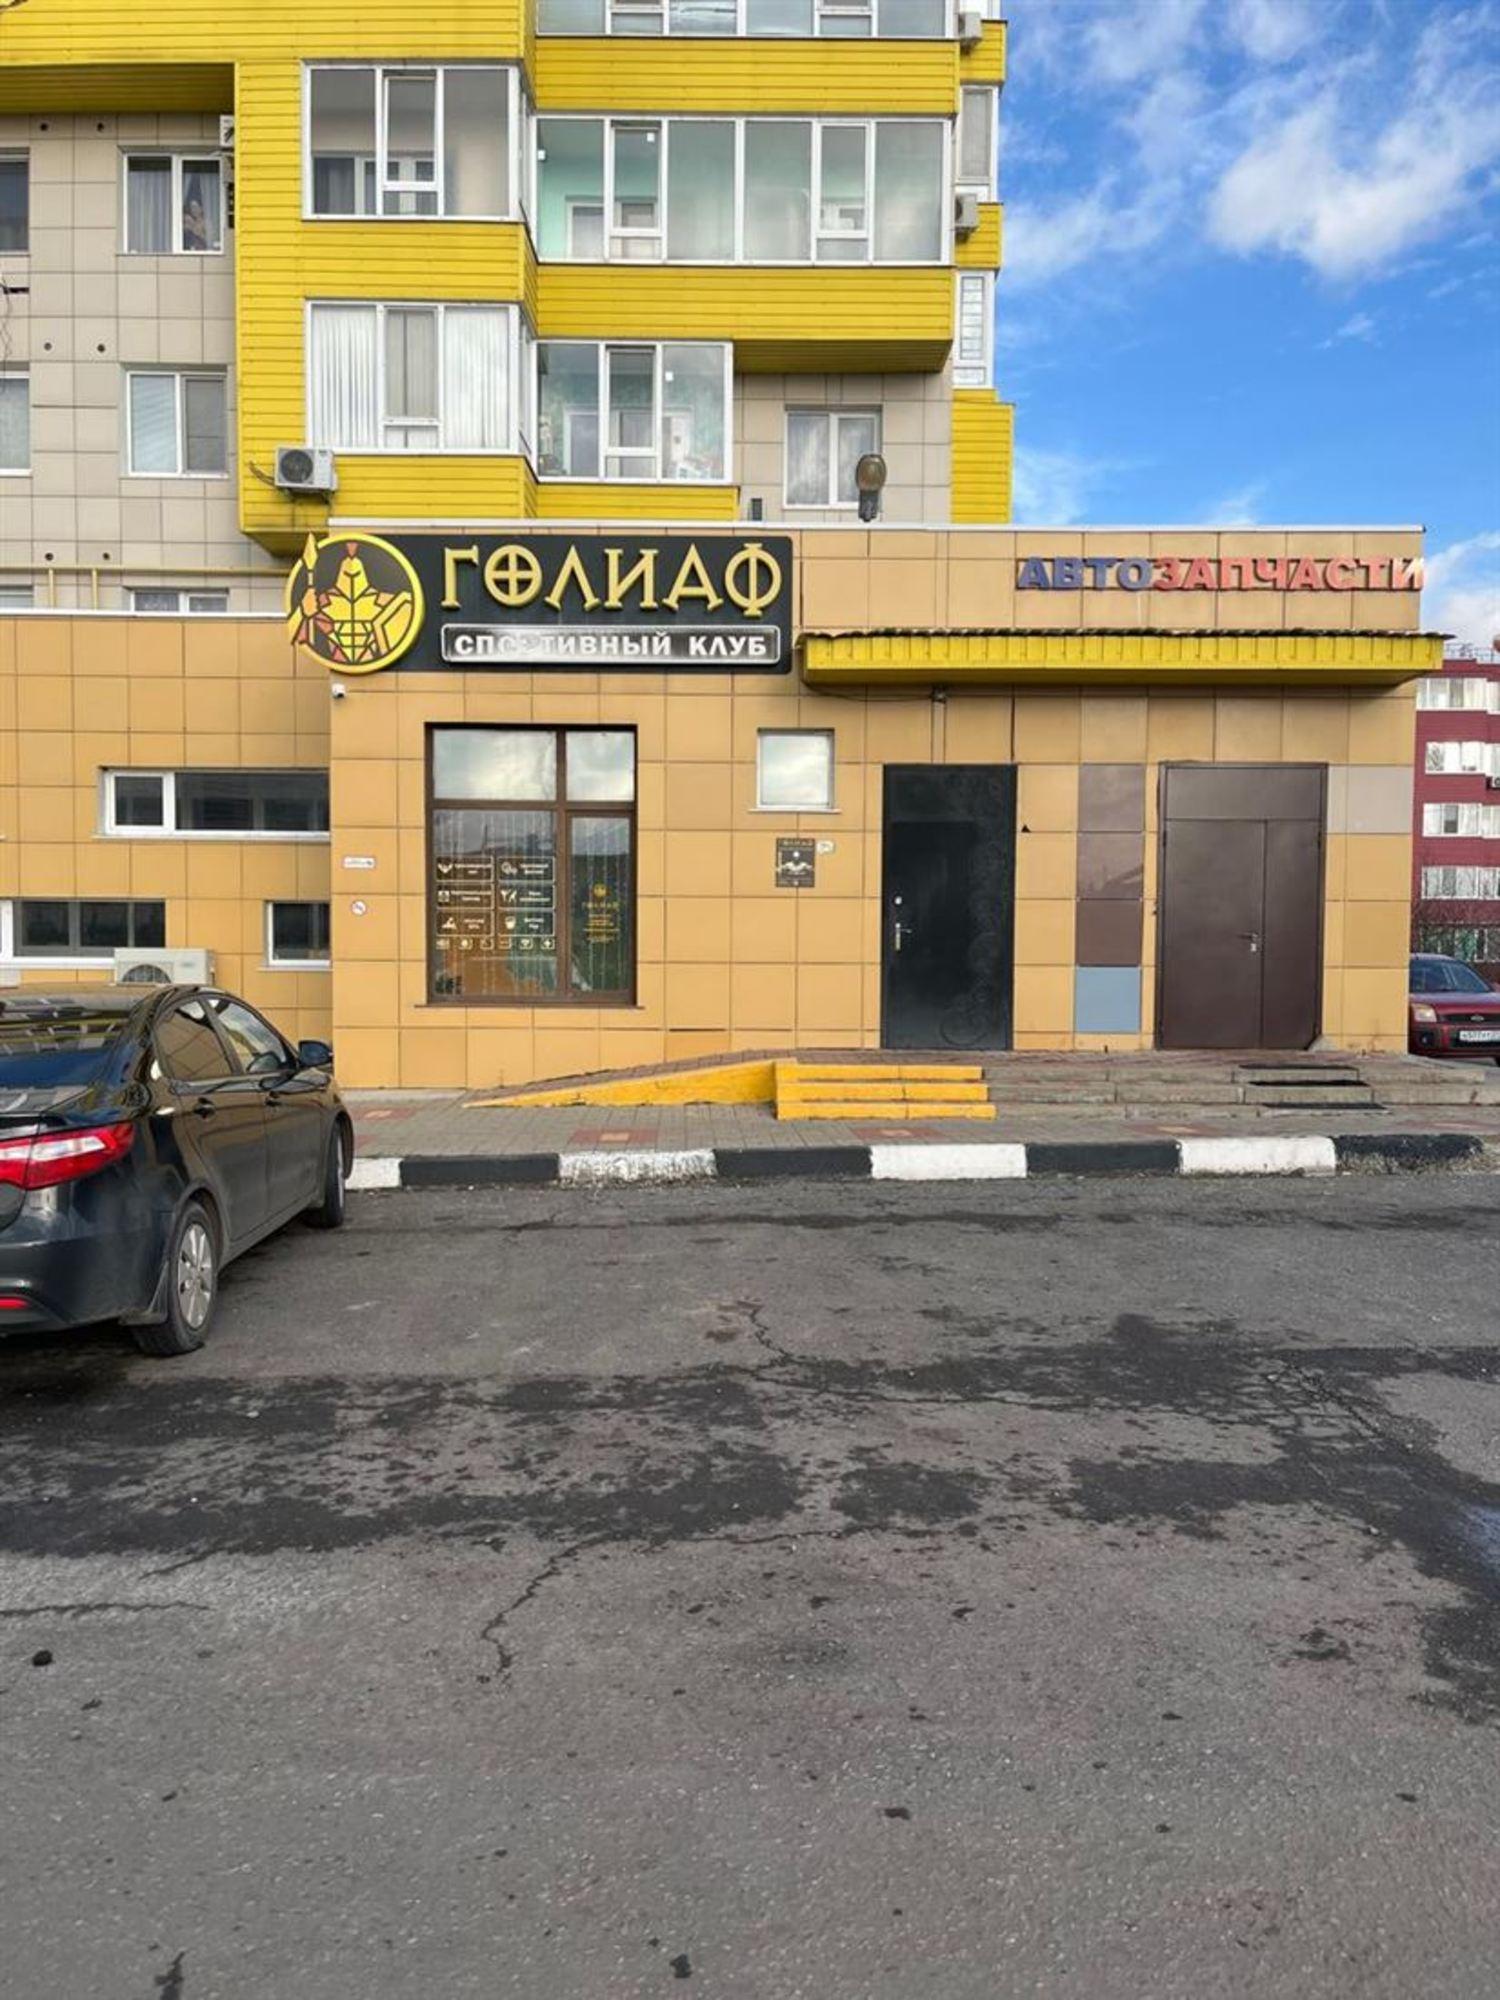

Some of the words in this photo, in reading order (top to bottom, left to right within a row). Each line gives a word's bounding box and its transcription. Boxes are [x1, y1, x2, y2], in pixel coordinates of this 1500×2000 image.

[441, 543, 782, 616] ГОЛИАФ
[1017, 557, 1424, 591] АВТОЗАПЧАСТИ
[688, 636, 768, 657] КЛУБ
